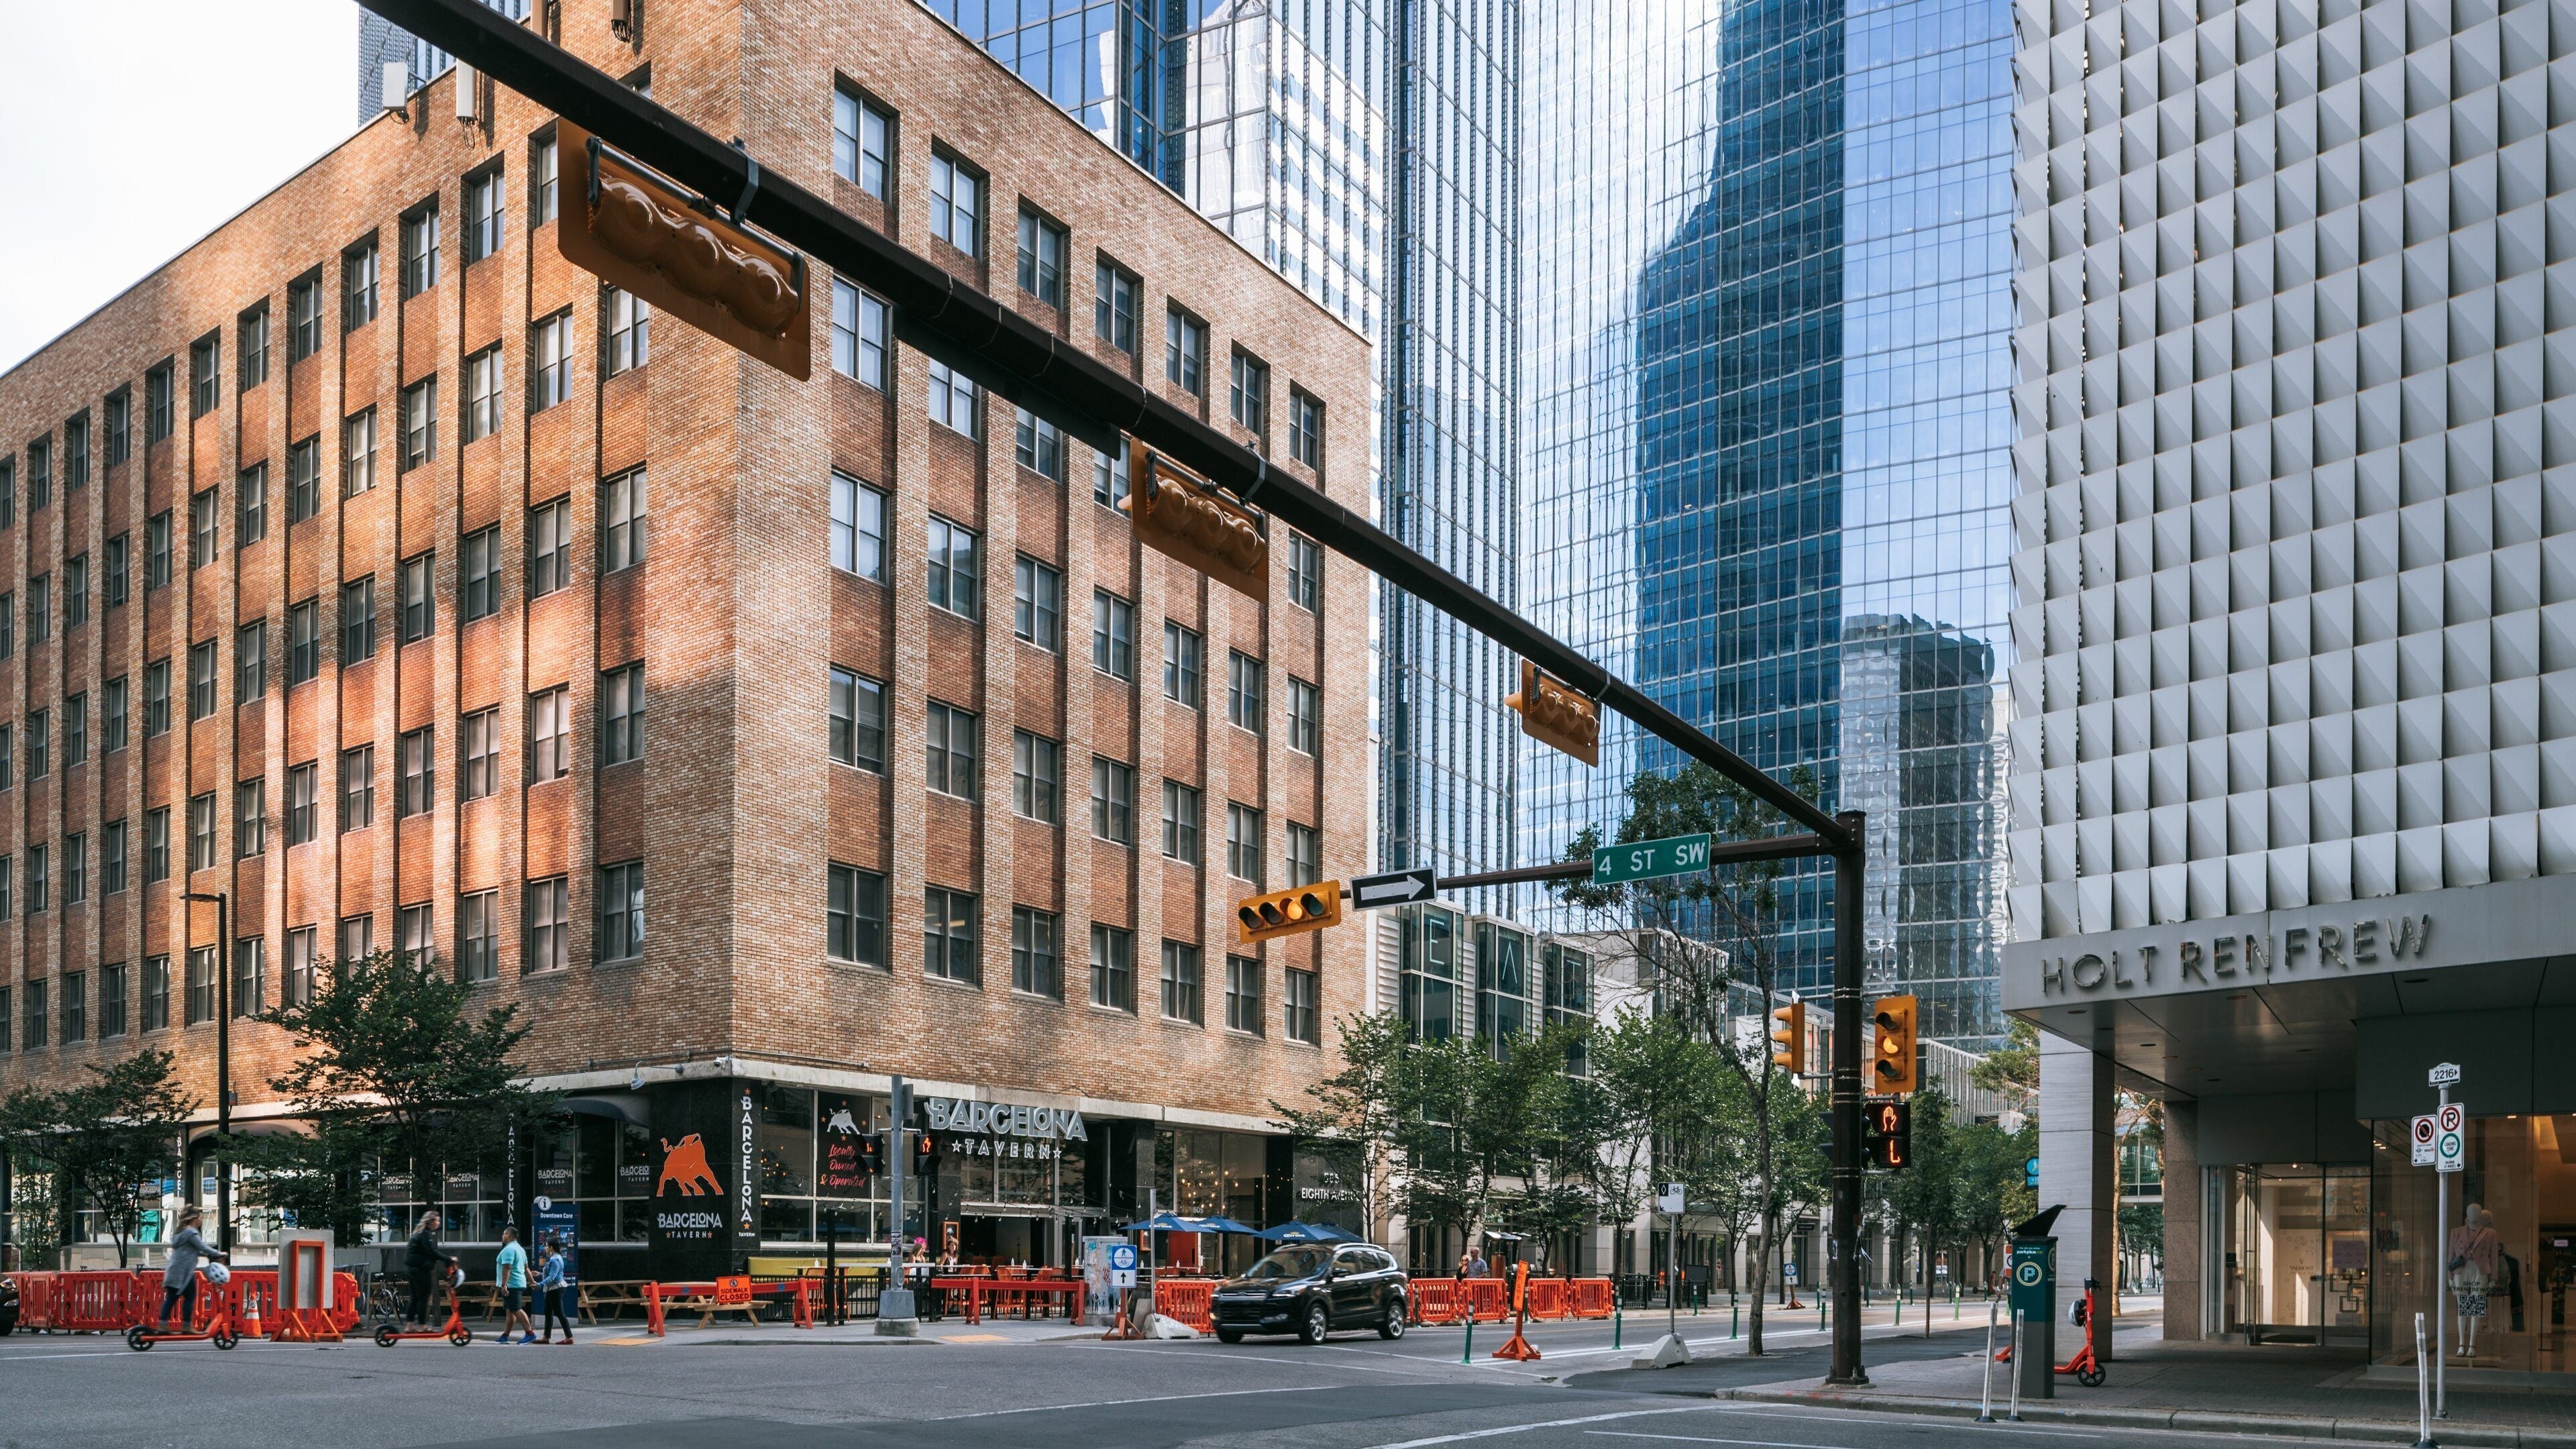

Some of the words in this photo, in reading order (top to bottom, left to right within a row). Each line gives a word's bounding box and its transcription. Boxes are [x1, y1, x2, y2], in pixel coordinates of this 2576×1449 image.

[1598, 855, 1611, 875] 4
[1630, 849, 1656, 871] ST
[1675, 842, 1706, 866] SW
[2041, 945, 2157, 993] HOLT
[2180, 914, 2430, 984] RENFREW
[2434, 1069, 2454, 1080] 2216
[924, 1097, 1088, 1142] BARCELONA
[828, 1144, 855, 1159] Locally
[965, 1138, 1050, 1159] TAVERN
[741, 1096, 753, 1222] BARCELONA
[829, 1159, 856, 1171] Owned
[537, 1169, 573, 1179] BARCELONA
[820, 1174, 828, 1186] &
[829, 1175, 866, 1189] Operated
[1301, 1187, 1329, 1199] EIGHTH
[657, 1212, 722, 1228] BARCELONA
